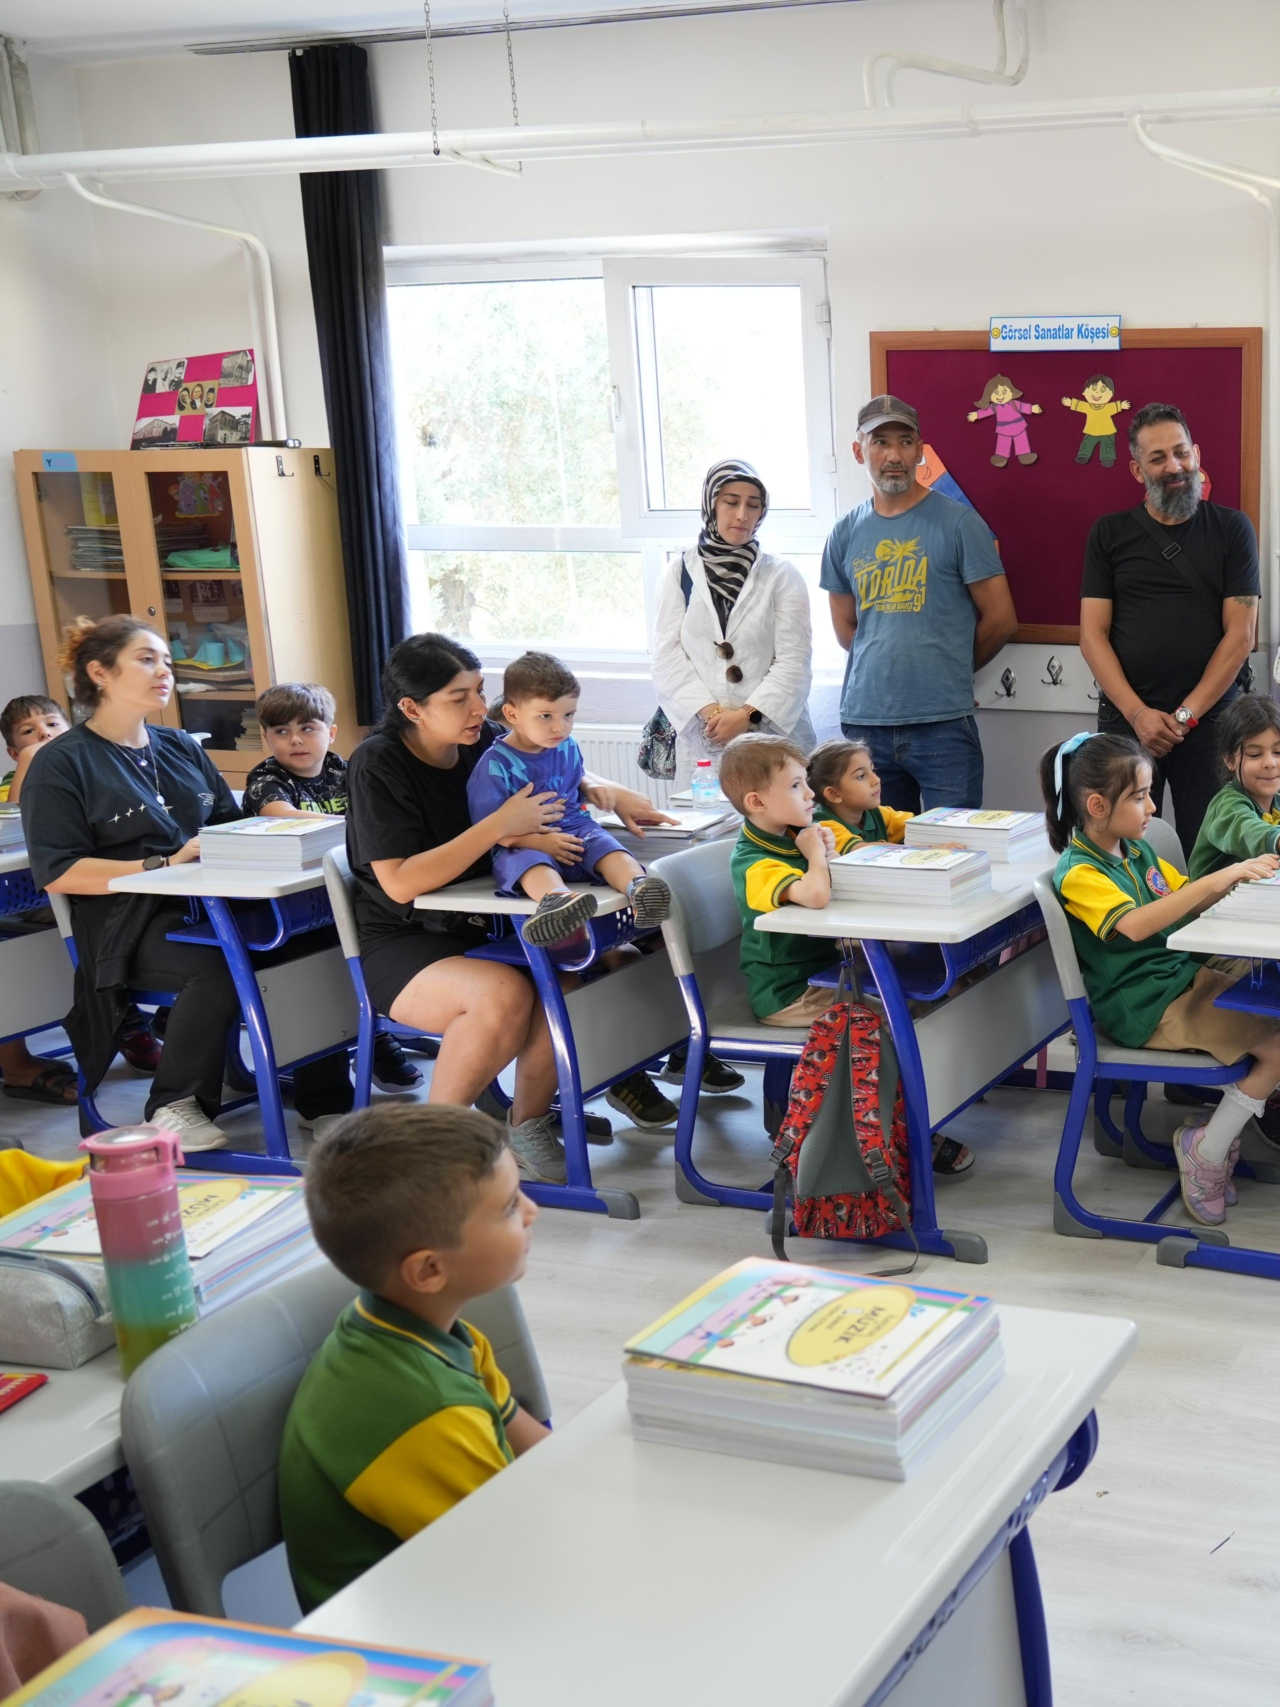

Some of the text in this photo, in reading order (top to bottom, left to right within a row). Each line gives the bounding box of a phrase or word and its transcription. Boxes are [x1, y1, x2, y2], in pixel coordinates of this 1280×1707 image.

[1001, 321, 1110, 344] Görsel Sanatlar Köşesi
